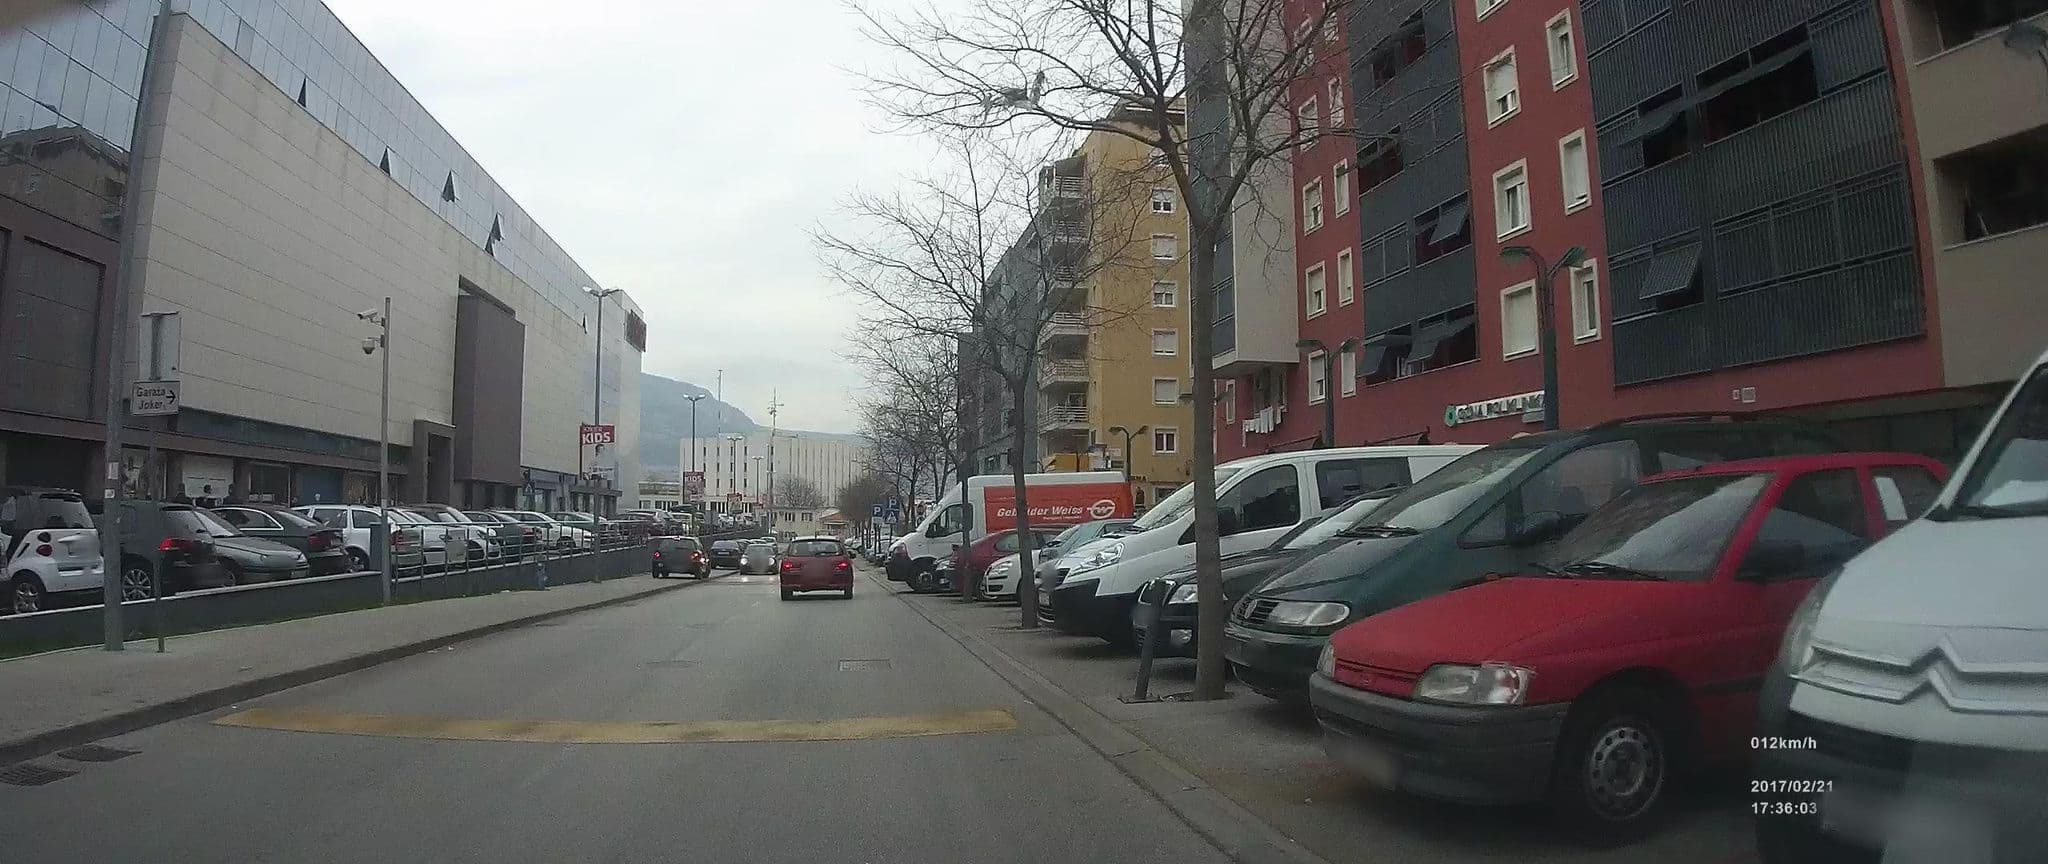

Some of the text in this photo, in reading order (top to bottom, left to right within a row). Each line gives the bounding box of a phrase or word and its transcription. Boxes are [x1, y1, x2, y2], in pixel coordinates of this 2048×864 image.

[138, 400, 163, 410] Joker
[582, 432, 611, 444] KIDS
[873, 506, 881, 515] P
[1051, 505, 1083, 516] Weiss
